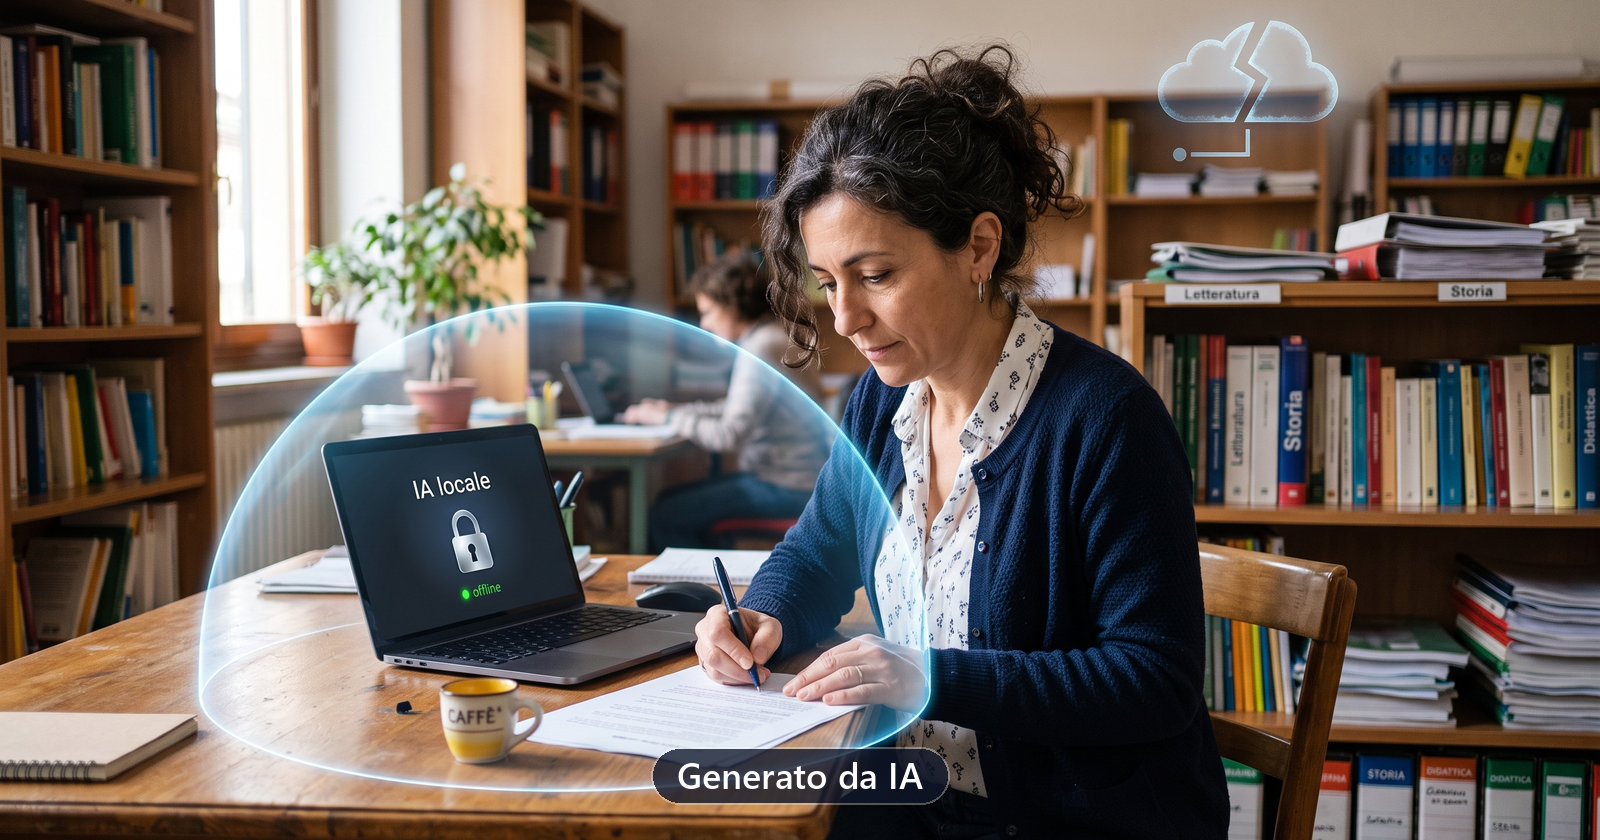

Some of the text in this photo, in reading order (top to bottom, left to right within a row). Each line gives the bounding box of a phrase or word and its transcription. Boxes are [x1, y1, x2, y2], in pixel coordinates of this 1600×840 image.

[1184, 287, 1260, 301] Letteratura
[1450, 284, 1494, 298] Storia
[1283, 390, 1303, 452] Storia
[1583, 387, 1597, 454] Didattica
[412, 471, 491, 500] IA locale
[473, 582, 501, 598] offline
[1367, 768, 1406, 781] STORIA
[1426, 766, 1473, 778] DIDATTICA
[1489, 775, 1532, 785] DIDATTICA
